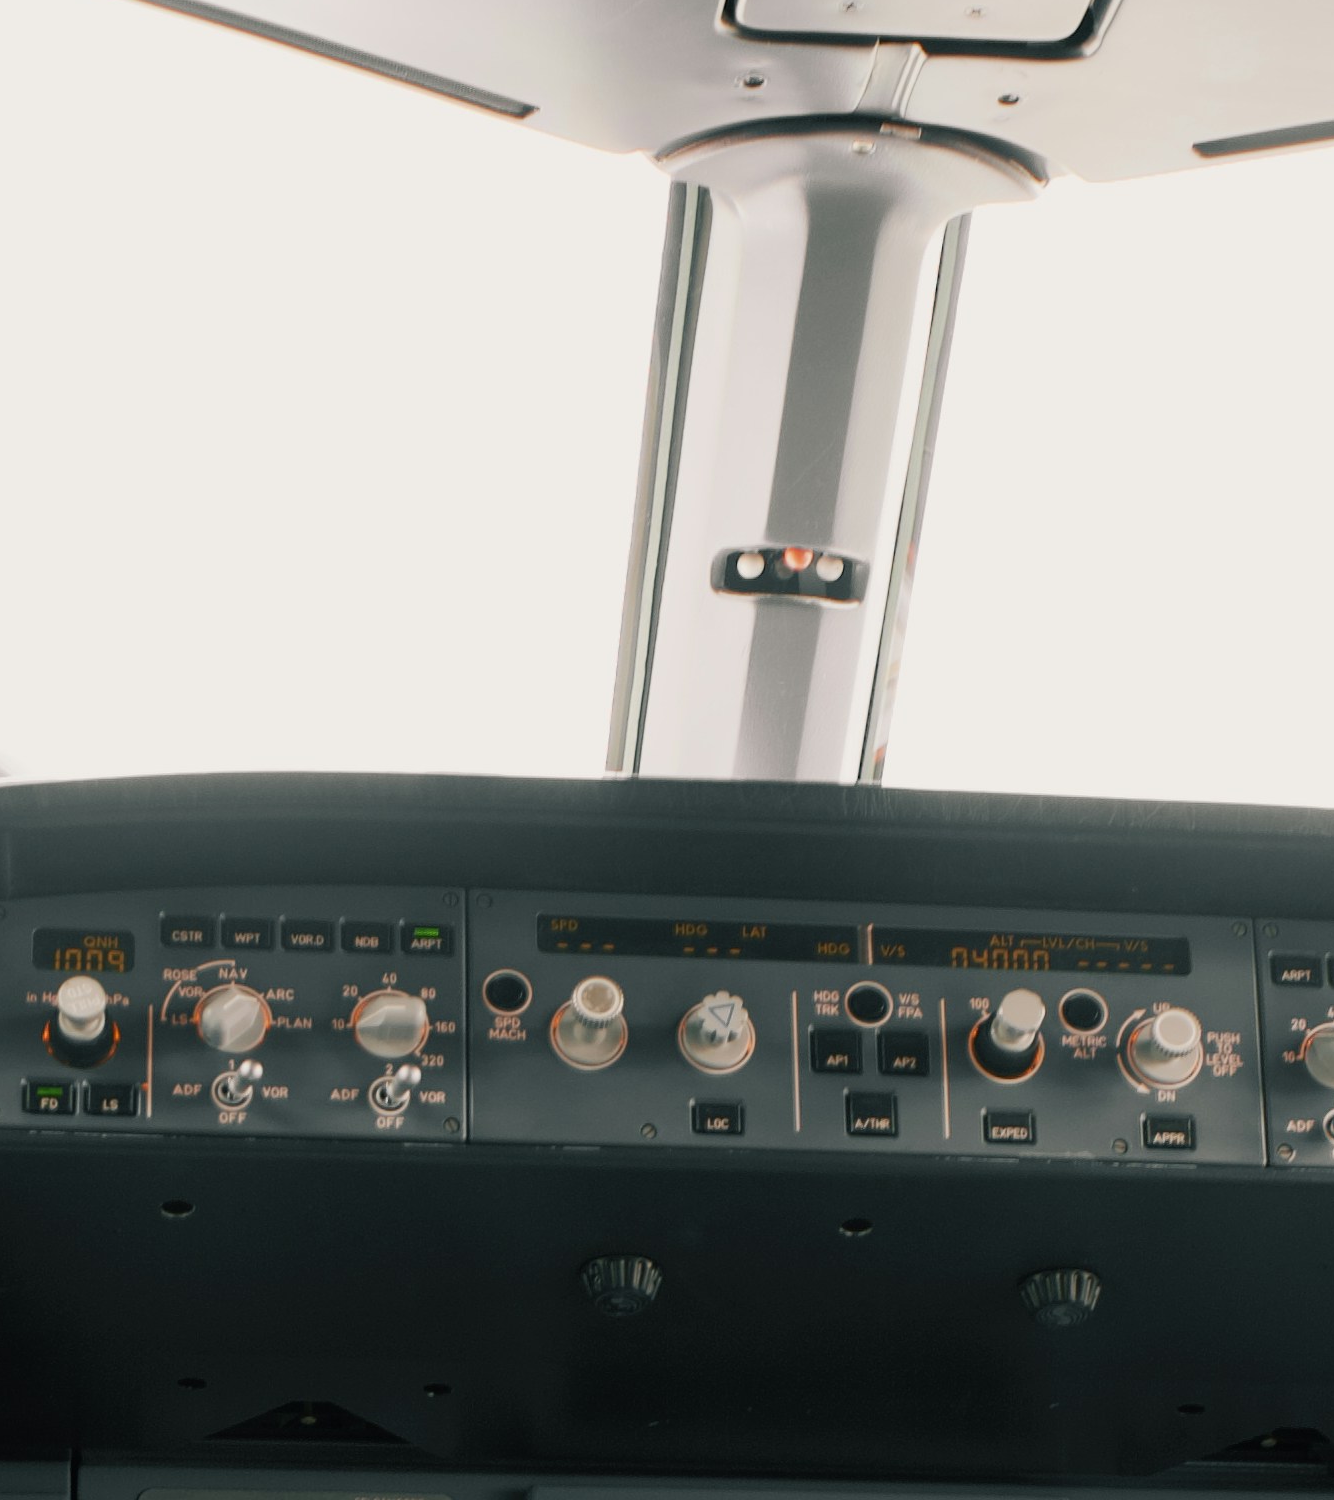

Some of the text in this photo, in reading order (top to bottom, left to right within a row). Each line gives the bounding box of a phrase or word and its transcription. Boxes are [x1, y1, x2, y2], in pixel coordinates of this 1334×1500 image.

[551, 919, 578, 931] SPD
[675, 924, 708, 936] HDG
[172, 930, 203, 942] CSTR
[742, 926, 766, 938] LAT
[84, 936, 118, 948] QNH
[235, 933, 261, 945] WPT
[291, 934, 324, 946] VOR.D
[355, 936, 378, 948] NDB
[410, 937, 442, 950] ARPT
[990, 935, 1015, 947] ALT
[163, 968, 197, 980] ROSE
[219, 968, 247, 979] NAV
[1282, 969, 1311, 982] ARPT
[266, 988, 294, 1000] ARC
[277, 1017, 312, 1028] PLAN
[494, 1017, 521, 1028] SPD
[488, 1029, 527, 1041] MACH
[1062, 1036, 1107, 1048] METRIC
[1074, 1047, 1097, 1059] ALT
[172, 1084, 201, 1095] ADF
[262, 1086, 288, 1098] VOR
[40, 1098, 58, 1110] FD
[218, 1112, 246, 1124] OFF
[706, 1118, 729, 1130] LOC
[855, 1117, 890, 1130] A/THR
[992, 1127, 1027, 1140] EXPED
[1153, 1132, 1185, 1145] APPR
